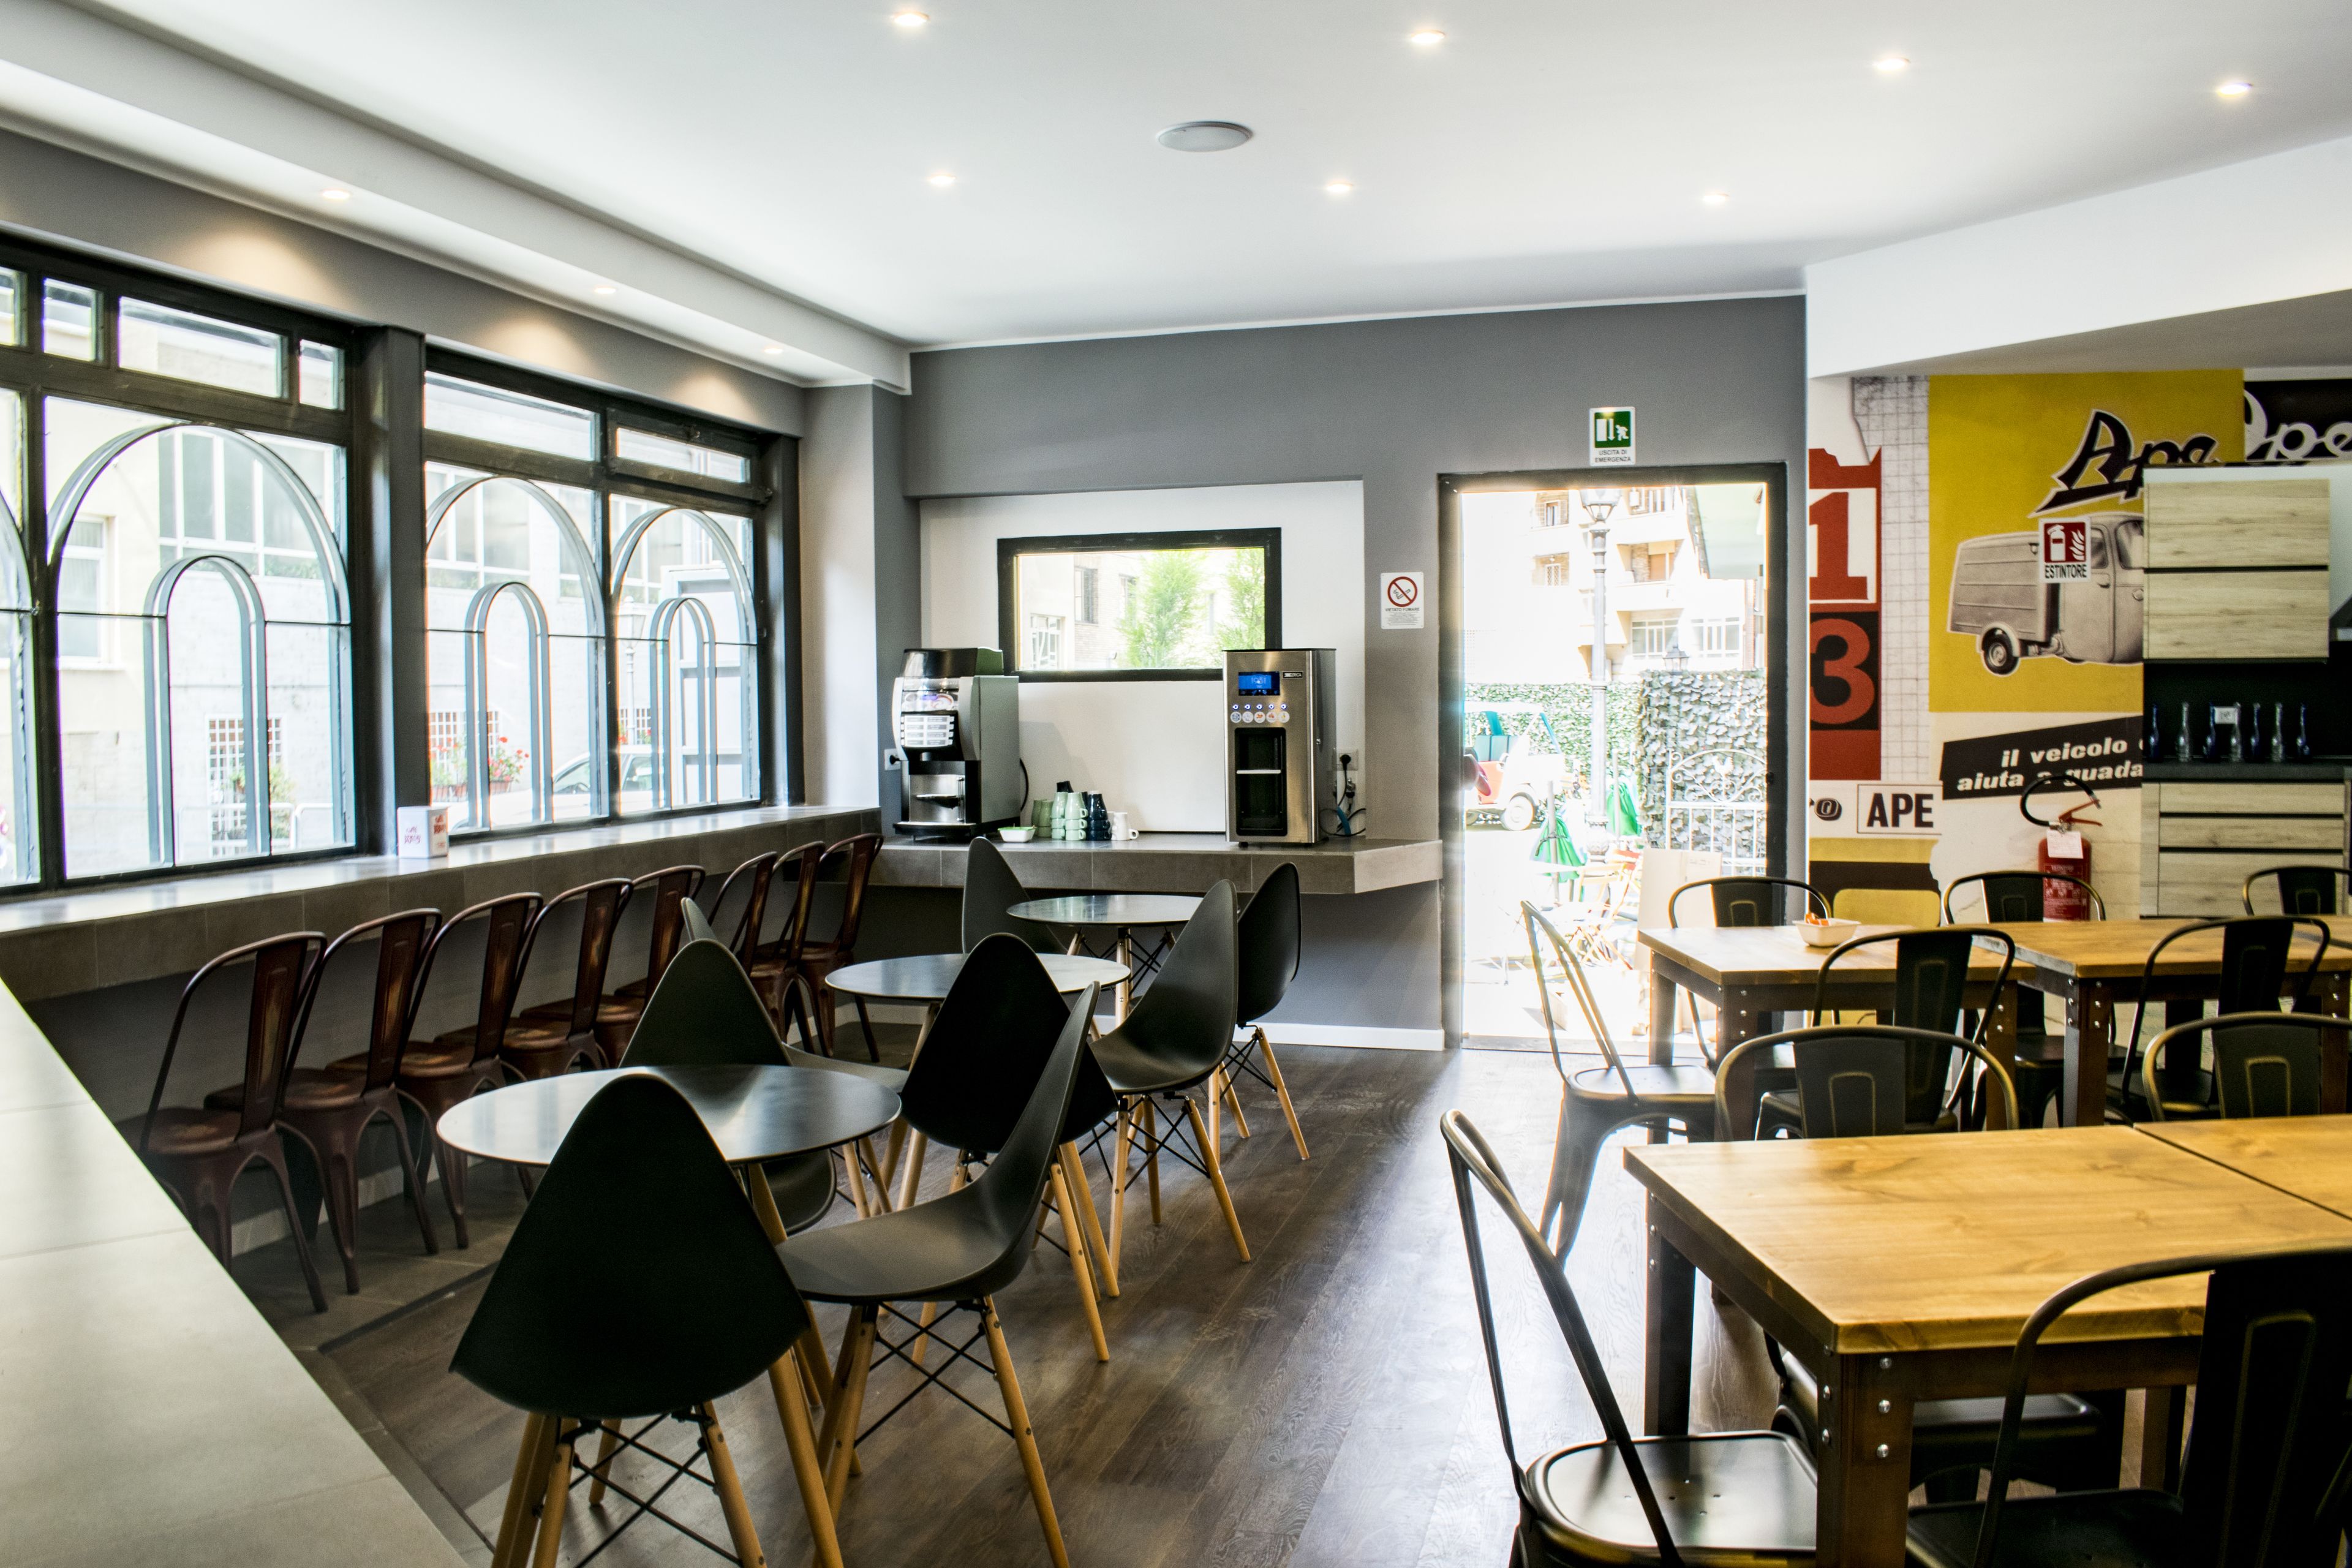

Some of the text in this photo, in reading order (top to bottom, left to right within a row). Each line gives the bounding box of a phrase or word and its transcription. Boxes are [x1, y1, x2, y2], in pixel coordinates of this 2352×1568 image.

[2045, 564, 2087, 579] ESTINTORE
[2001, 749, 2019, 767] il
[2030, 737, 2128, 764] veicolo
[1957, 771, 2024, 791] aiuta
[1867, 793, 1934, 827] APE
